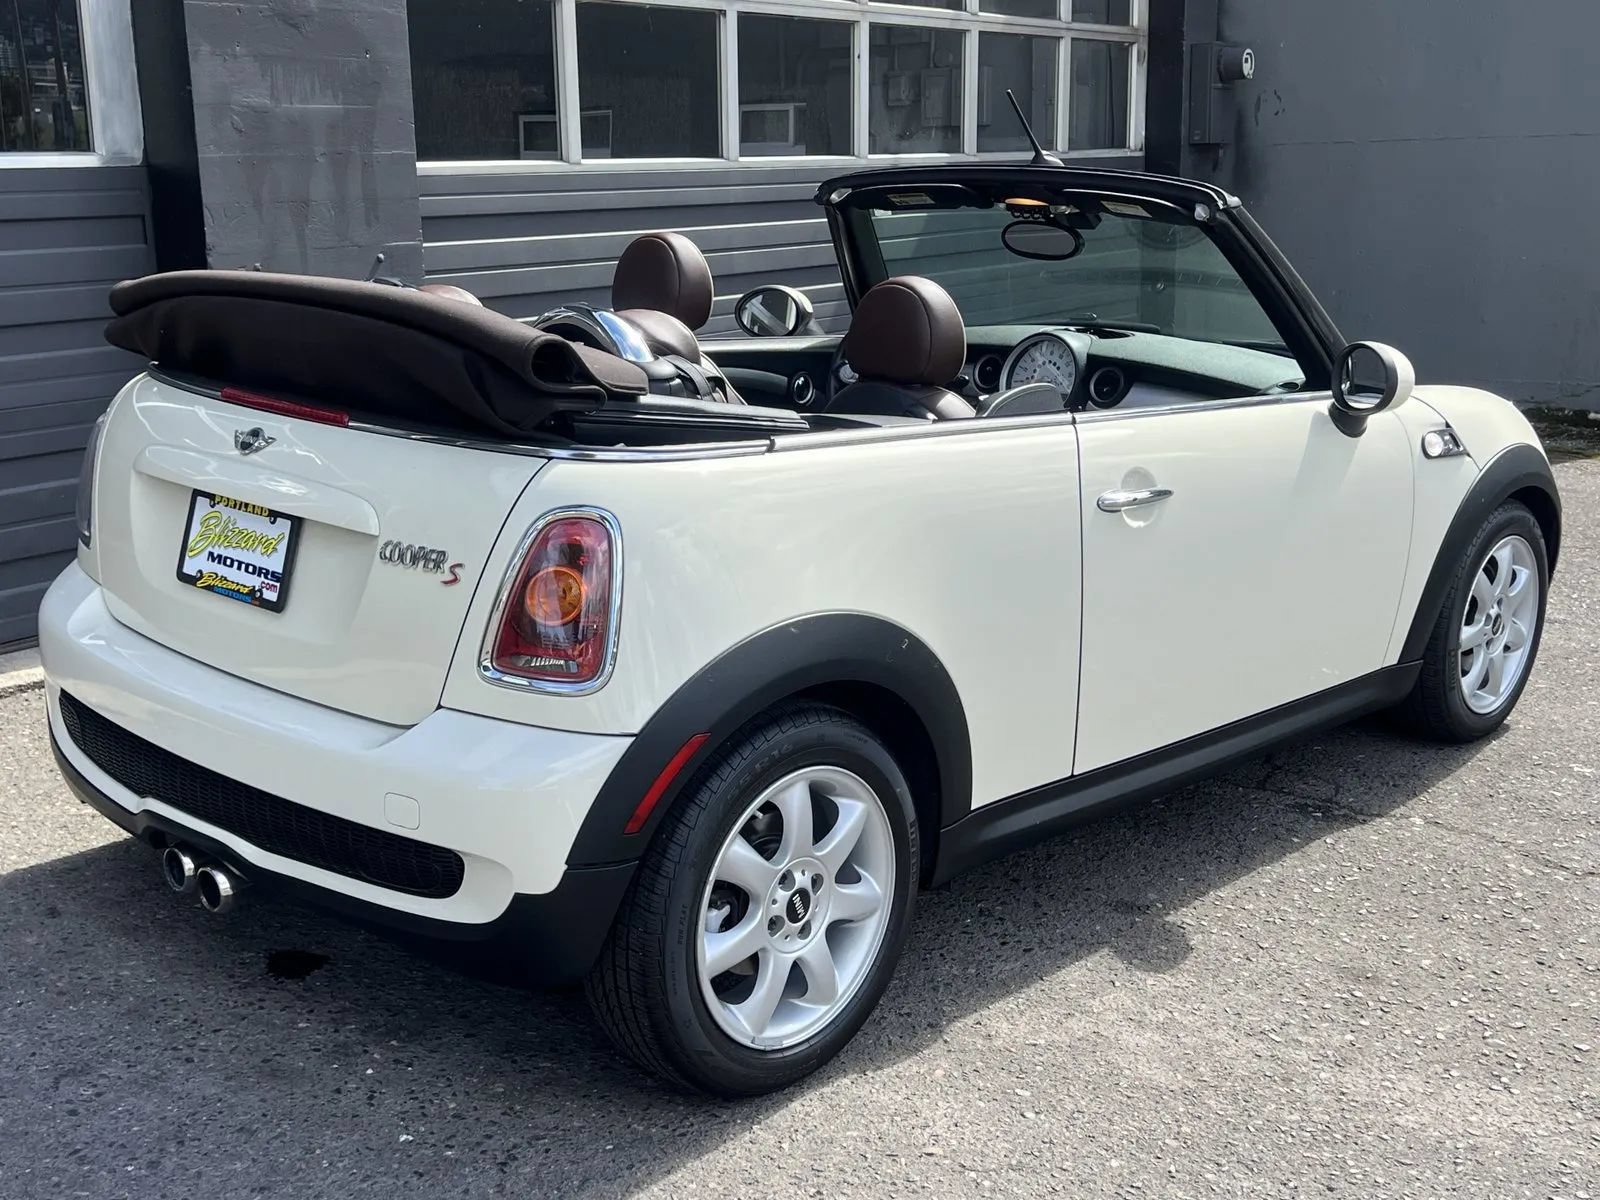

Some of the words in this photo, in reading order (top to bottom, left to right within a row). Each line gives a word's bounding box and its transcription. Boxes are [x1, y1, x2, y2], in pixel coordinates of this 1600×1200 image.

[214, 494, 269, 517] PORTLAND
[187, 510, 285, 558] Blizzard
[206, 551, 283, 581] MOTORS
[379, 540, 449, 574] COOPER
[440, 562, 466, 587] S
[196, 571, 253, 594] Blizzard
[213, 586, 252, 603] MOTORS
[792, 893, 805, 919] MINI
